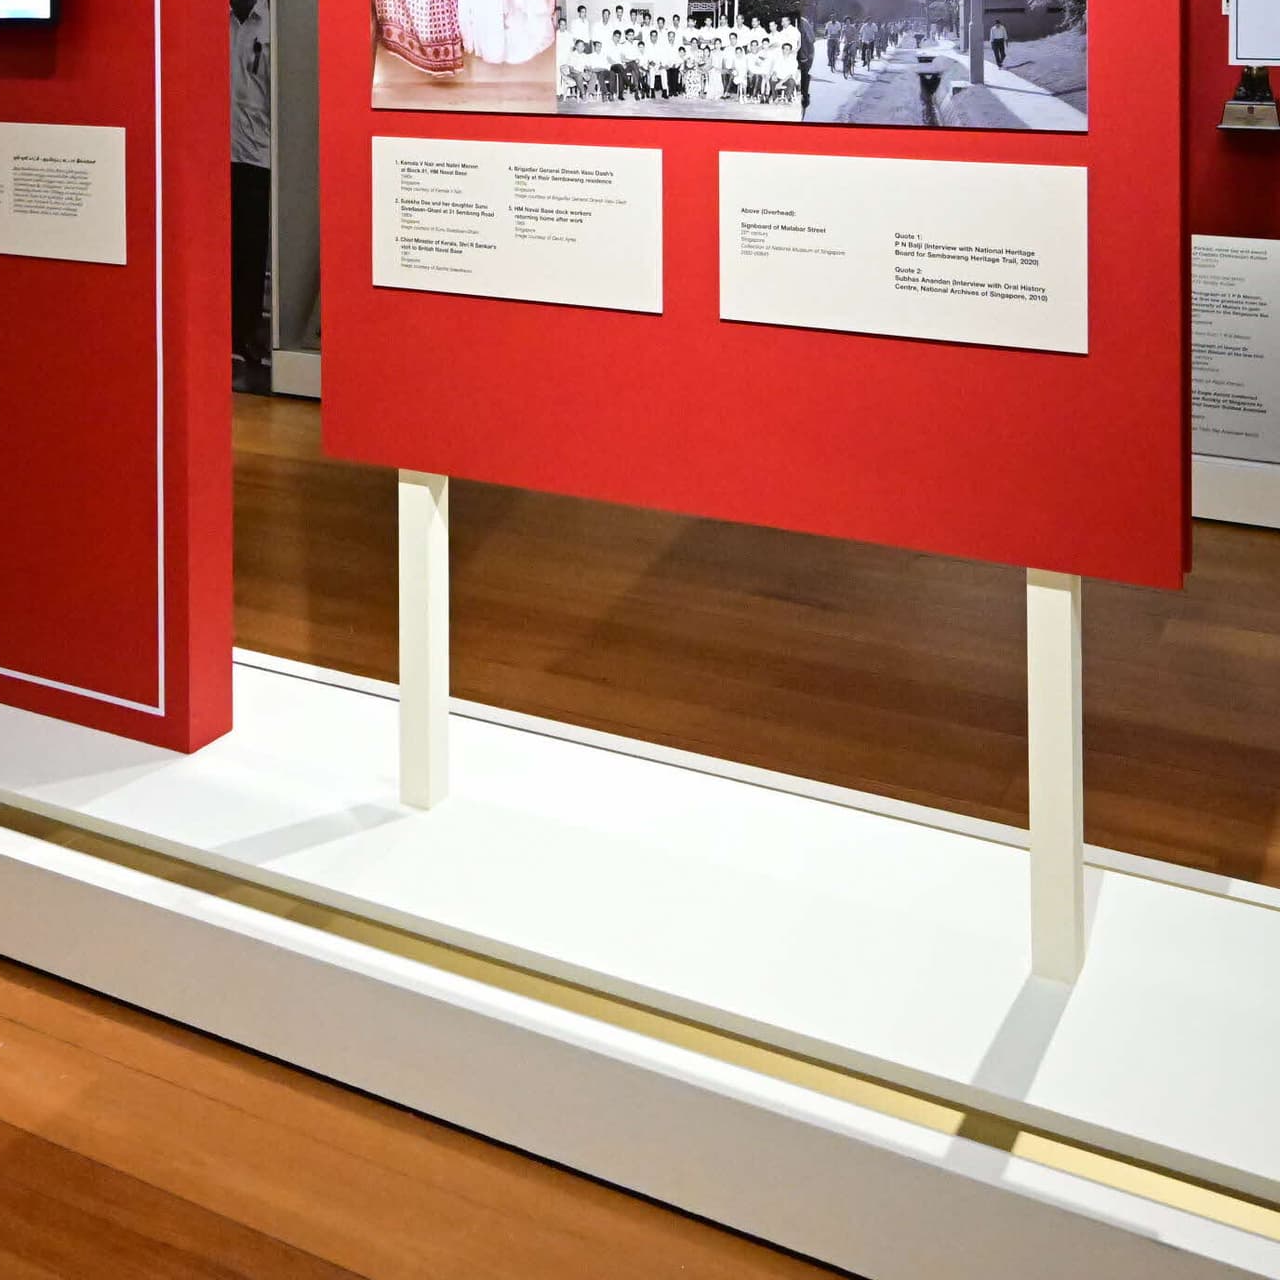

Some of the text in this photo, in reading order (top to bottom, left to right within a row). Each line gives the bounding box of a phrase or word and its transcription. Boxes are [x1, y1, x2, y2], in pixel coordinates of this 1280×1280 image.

[761, 209, 797, 217] (Overhead):
[741, 222, 772, 231] Signboard
[894, 232, 915, 240] Quote
[908, 242, 922, 250] Balji
[974, 246, 1004, 254] National
[1005, 248, 1035, 257] Heritage
[927, 252, 969, 262] Sembawang
[970, 255, 1000, 264] Heritage
[1002, 257, 1018, 265] Trail,
[1020, 258, 1039, 267] 2020)
[894, 275, 920, 283] Subhas
[921, 277, 951, 285] Anandan
[1020, 284, 1046, 294] History
[894, 283, 919, 292] Centre,
[920, 286, 949, 294] National
[950, 288, 979, 296] Archives
[989, 291, 1027, 301] Singapore,
[1029, 294, 1048, 303] 2010)
